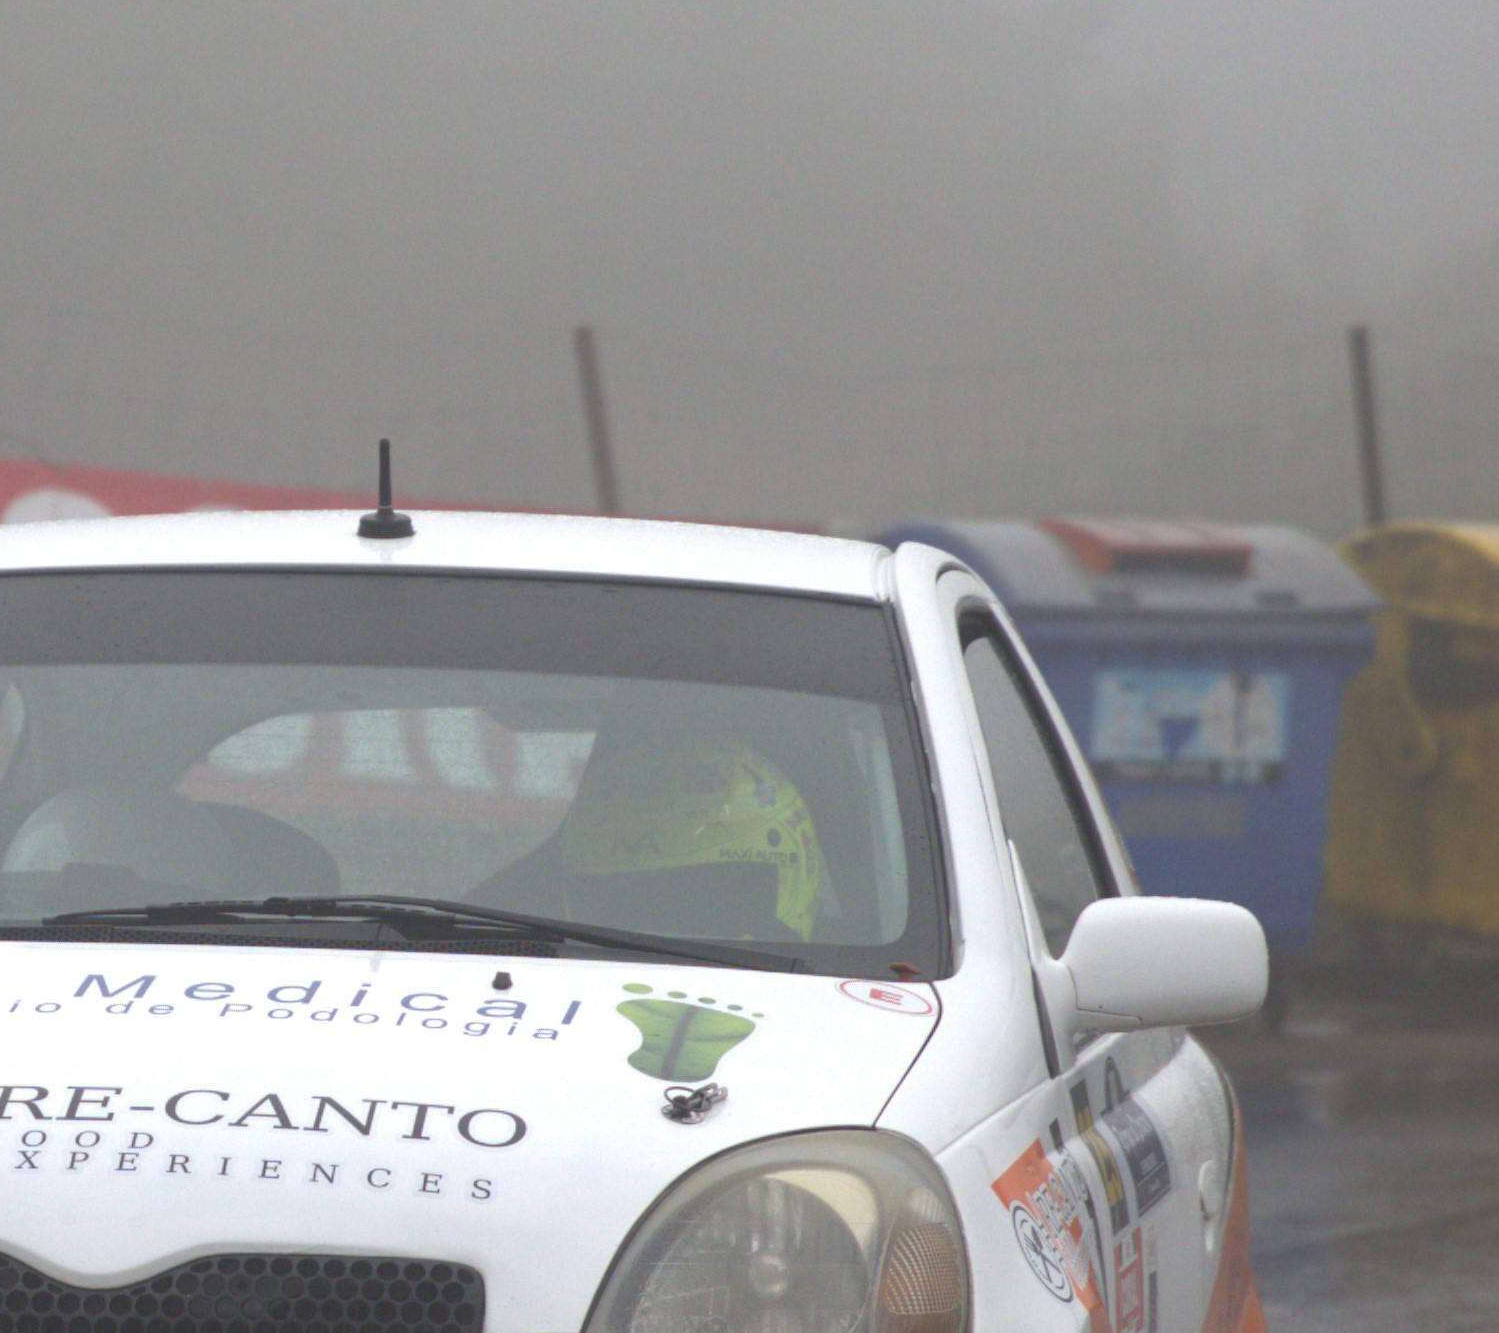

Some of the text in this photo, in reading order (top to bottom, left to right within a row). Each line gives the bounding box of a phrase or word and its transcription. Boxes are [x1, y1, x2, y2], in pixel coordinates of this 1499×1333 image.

[73, 973, 582, 1026] Medical
[104, 997, 175, 1016] de
[218, 1001, 560, 1041] Podologia
